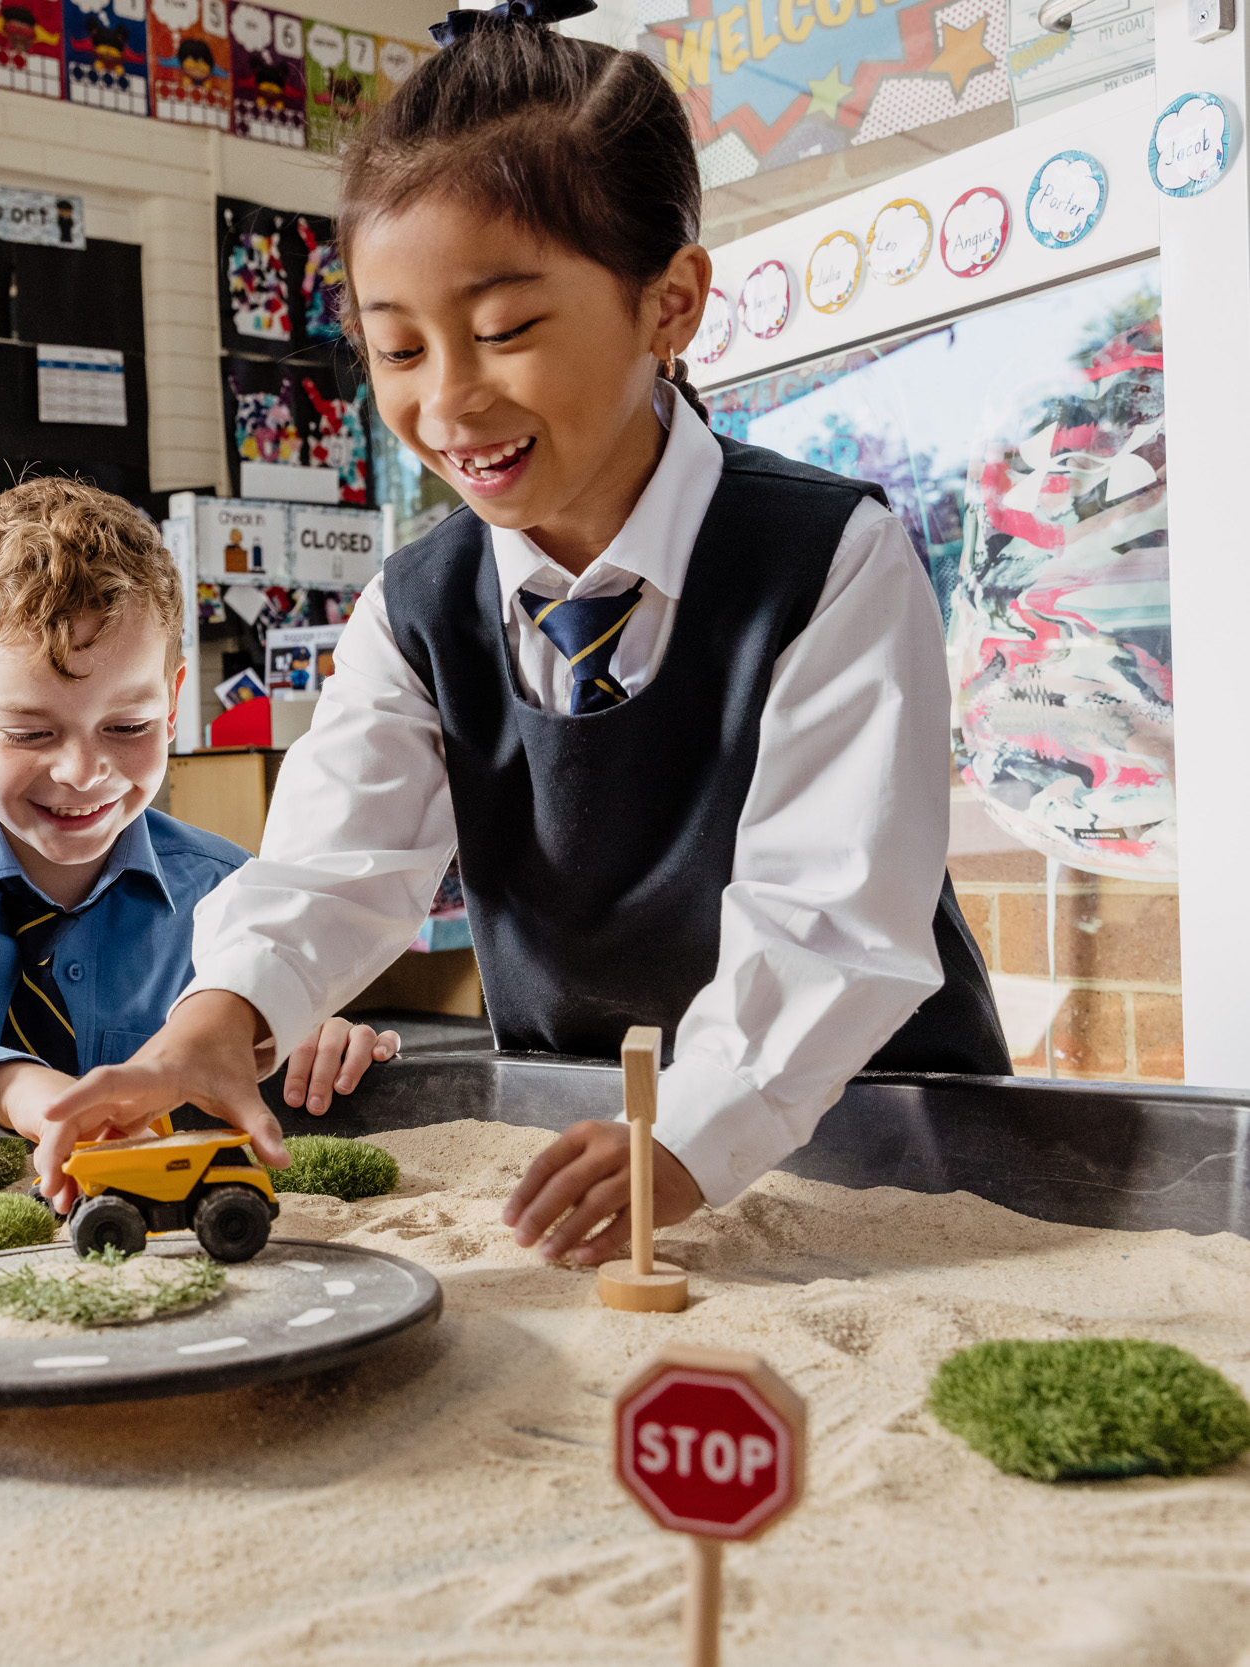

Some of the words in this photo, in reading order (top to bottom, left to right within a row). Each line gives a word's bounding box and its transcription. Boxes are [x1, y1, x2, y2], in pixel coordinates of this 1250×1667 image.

[208, 0, 222, 28] 5
[282, 23, 296, 49] 6
[1098, 24, 1115, 42] MY
[355, 38, 367, 65] 7
[663, 0, 904, 95] WELC
[1165, 128, 1211, 166] Jacob
[1039, 183, 1085, 217] Porter
[876, 231, 898, 252] Leo
[952, 227, 993, 255] Angus
[814, 262, 842, 288] Julia
[218, 509, 253, 527] Check
[254, 512, 266, 527] in
[301, 529, 373, 553] CLOSED
[637, 1420, 775, 1488] STOP
